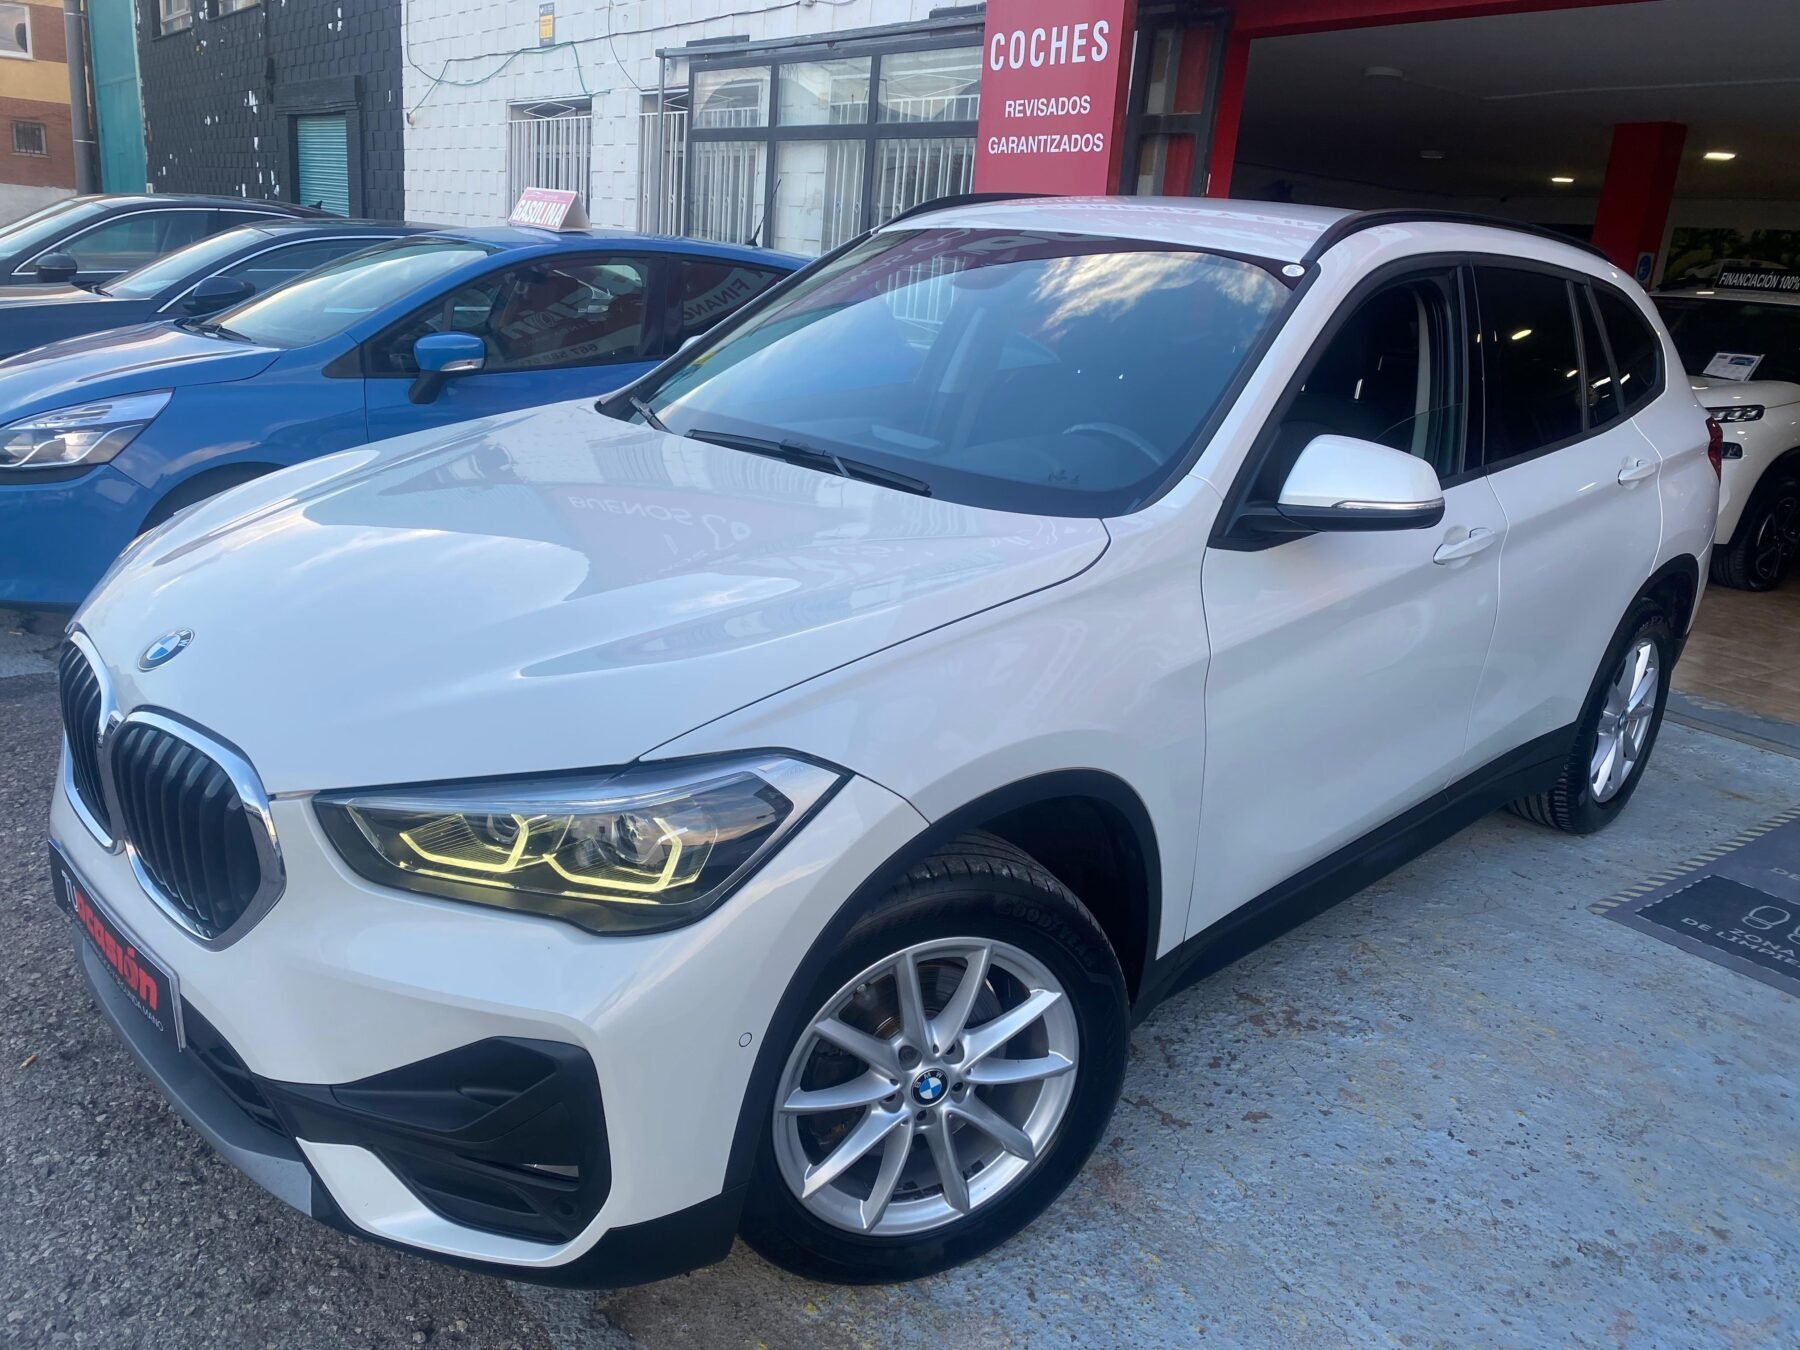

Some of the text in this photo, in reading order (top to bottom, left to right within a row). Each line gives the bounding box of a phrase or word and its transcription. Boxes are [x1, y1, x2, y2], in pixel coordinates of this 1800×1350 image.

[990, 20, 1109, 71] COCHES
[1004, 95, 1091, 119] REVISADOS
[987, 132, 1104, 155] GARANTIZADOS
[511, 199, 567, 227] GASOLINA
[1718, 271, 1800, 291] FINANCIACIÓN 100%
[1681, 917, 1800, 969] DE LIMPIE
[1728, 927, 1796, 958] ZONA
